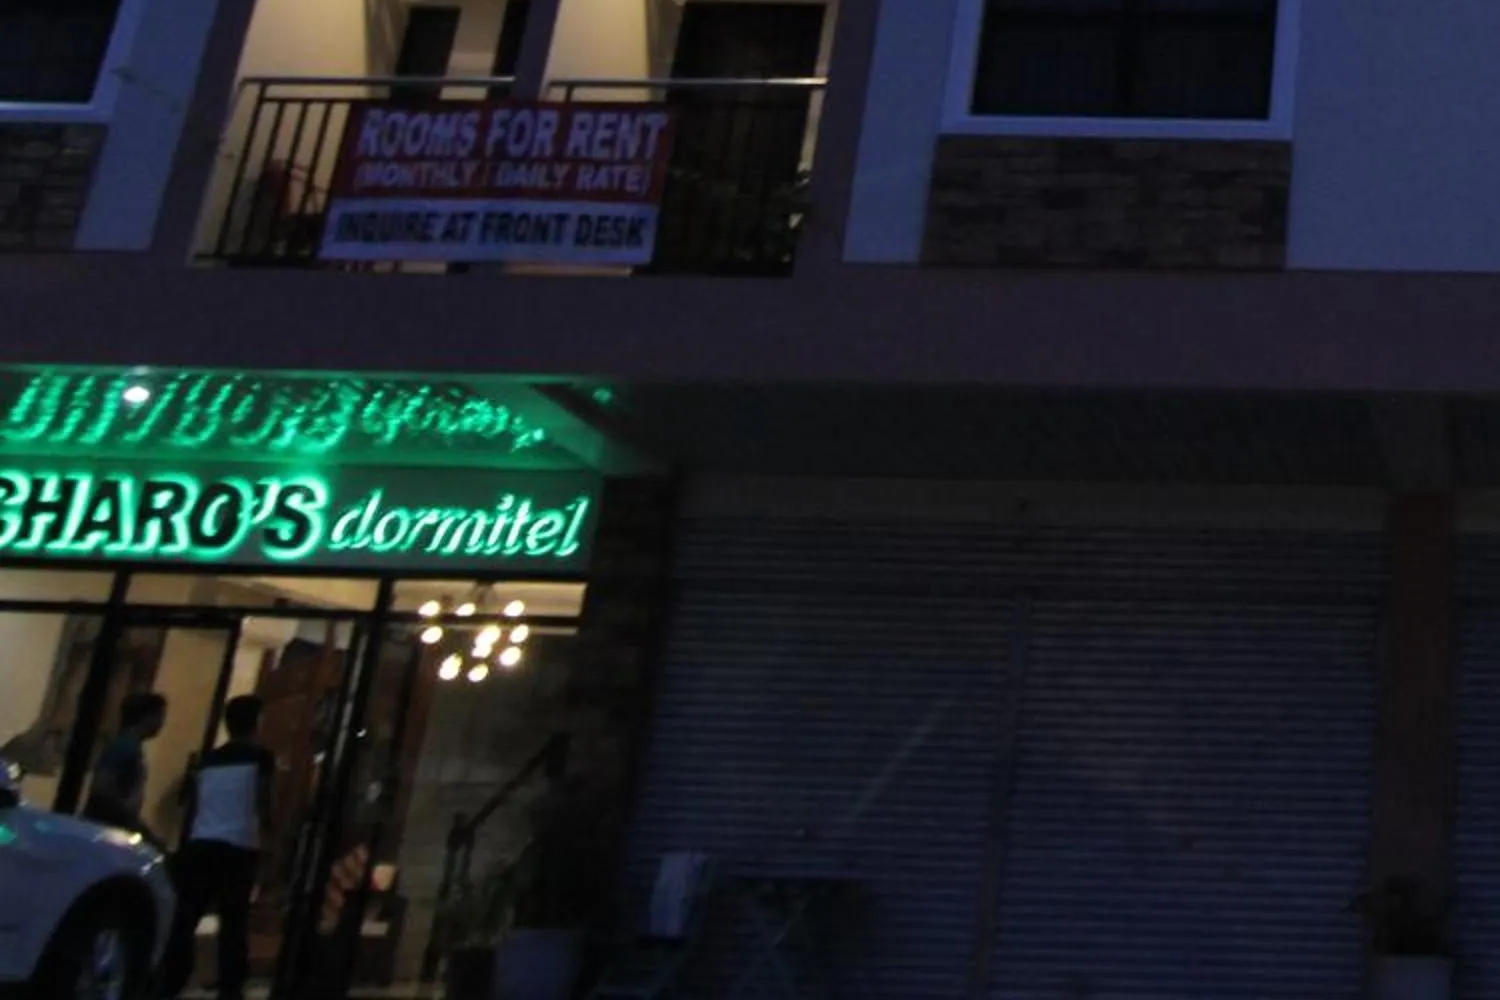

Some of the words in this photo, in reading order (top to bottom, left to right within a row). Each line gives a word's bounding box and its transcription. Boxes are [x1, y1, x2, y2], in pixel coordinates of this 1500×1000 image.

[357, 108, 480, 158] ROOMS
[486, 108, 558, 157] FOR
[567, 112, 669, 160] RENT
[494, 163, 568, 188] DAILY
[575, 164, 653, 194] RATE)
[335, 211, 438, 243] INQUIRE
[440, 212, 475, 243] AT
[479, 213, 569, 245] FRONT
[574, 215, 647, 247] DESK
[330, 488, 590, 558] dormitel
